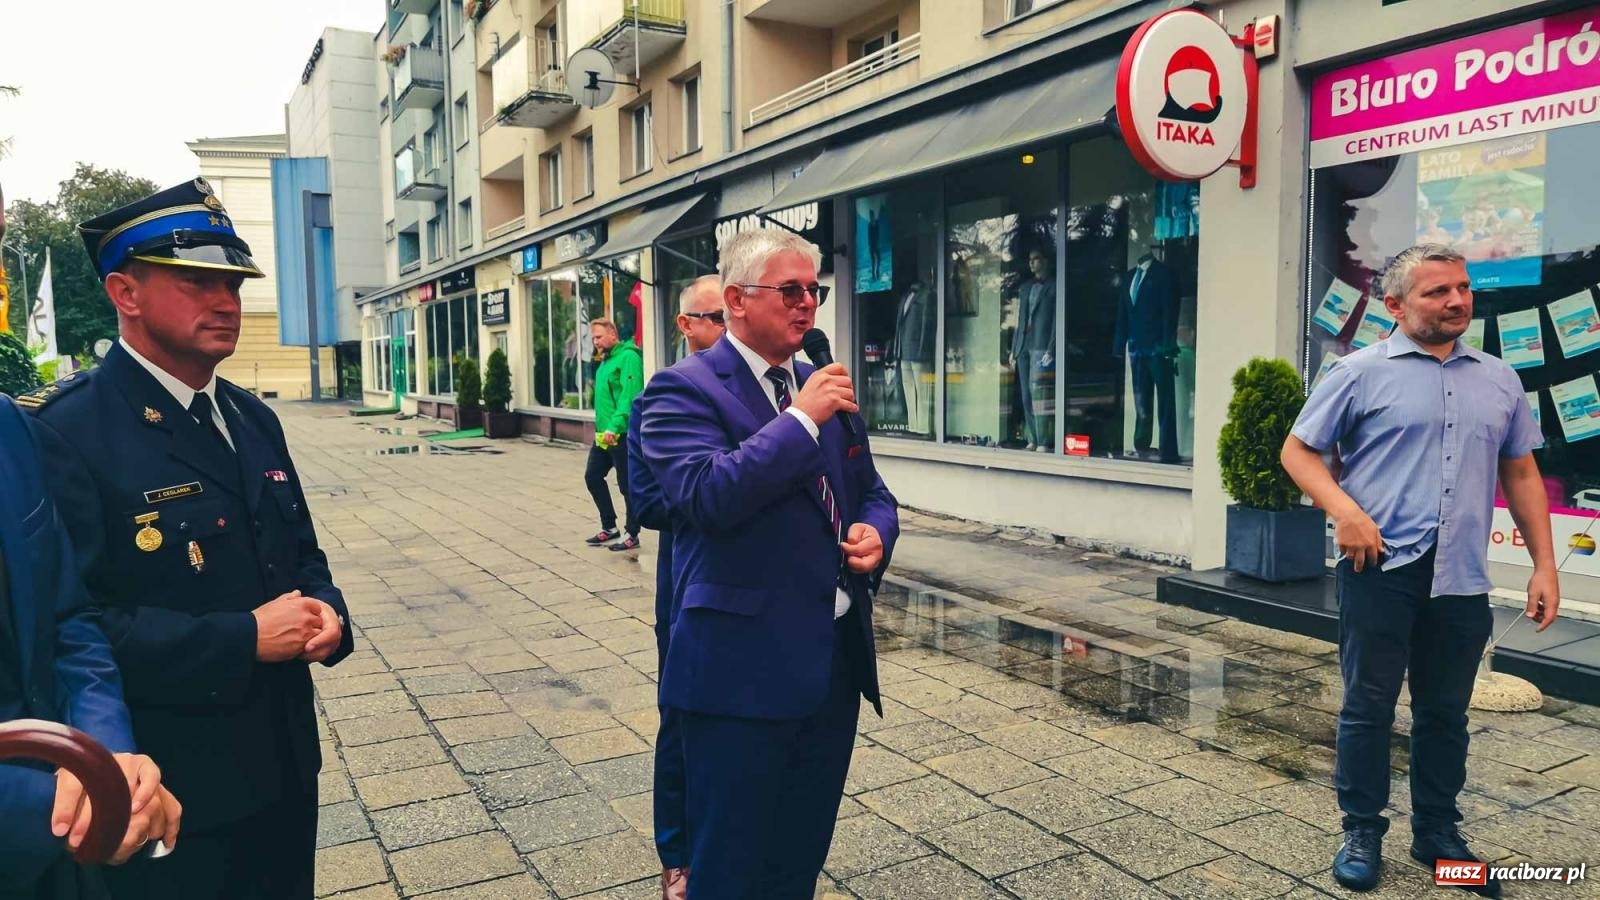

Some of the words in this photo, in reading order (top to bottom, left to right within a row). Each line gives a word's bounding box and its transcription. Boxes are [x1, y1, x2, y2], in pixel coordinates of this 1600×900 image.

[1331, 68, 1438, 117] Biuro
[1454, 21, 1600, 91] Podró
[1157, 121, 1215, 146] ITAKA
[1345, 123, 1449, 155] CENTRUM
[1458, 112, 1514, 136] LAST
[1521, 95, 1600, 125] MINU
[1420, 151, 1461, 166] LATO
[1420, 162, 1479, 183] FAMILY
